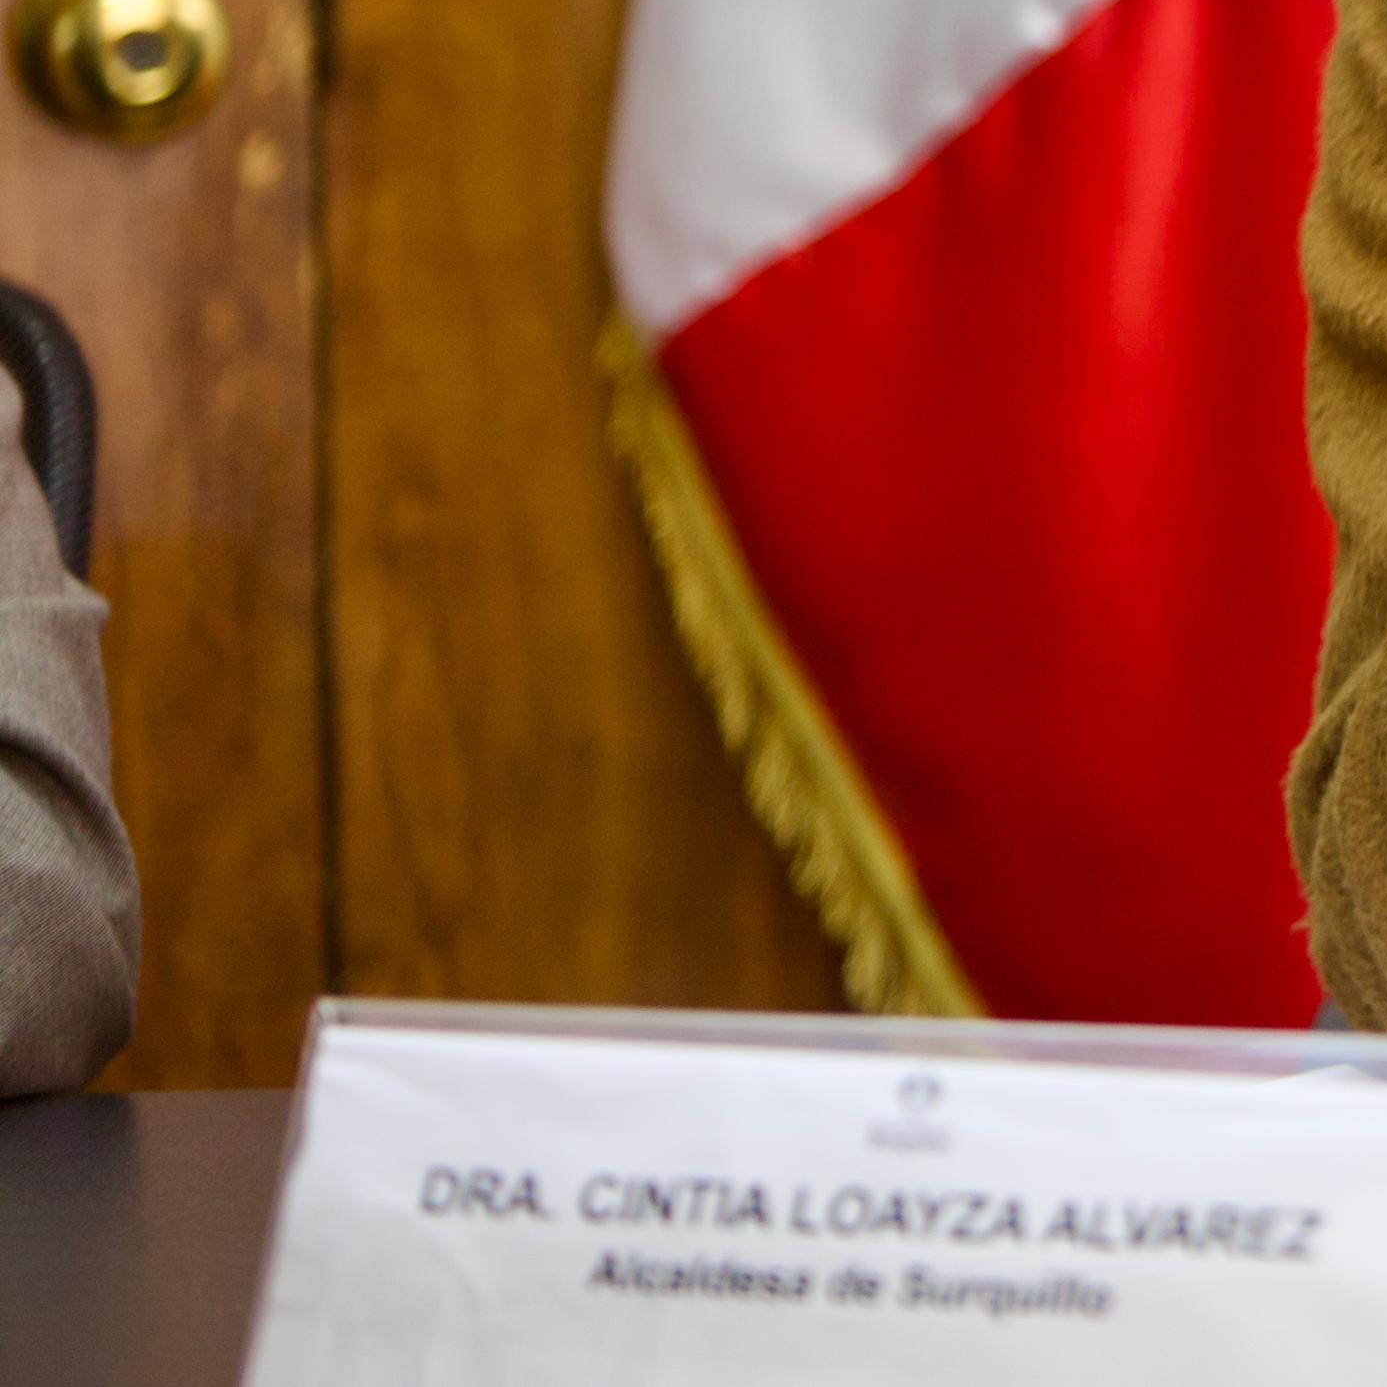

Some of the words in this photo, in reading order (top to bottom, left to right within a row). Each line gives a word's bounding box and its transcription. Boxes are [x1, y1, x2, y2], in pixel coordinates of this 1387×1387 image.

[579, 1174, 770, 1226] CINTIA
[789, 1186, 1024, 1241] LOAYZA
[1047, 1200, 1322, 1262] ALVAREZ
[591, 1251, 811, 1298] Alcaldesa
[828, 1265, 882, 1302] de
[901, 1267, 1113, 1319] Surquillo
